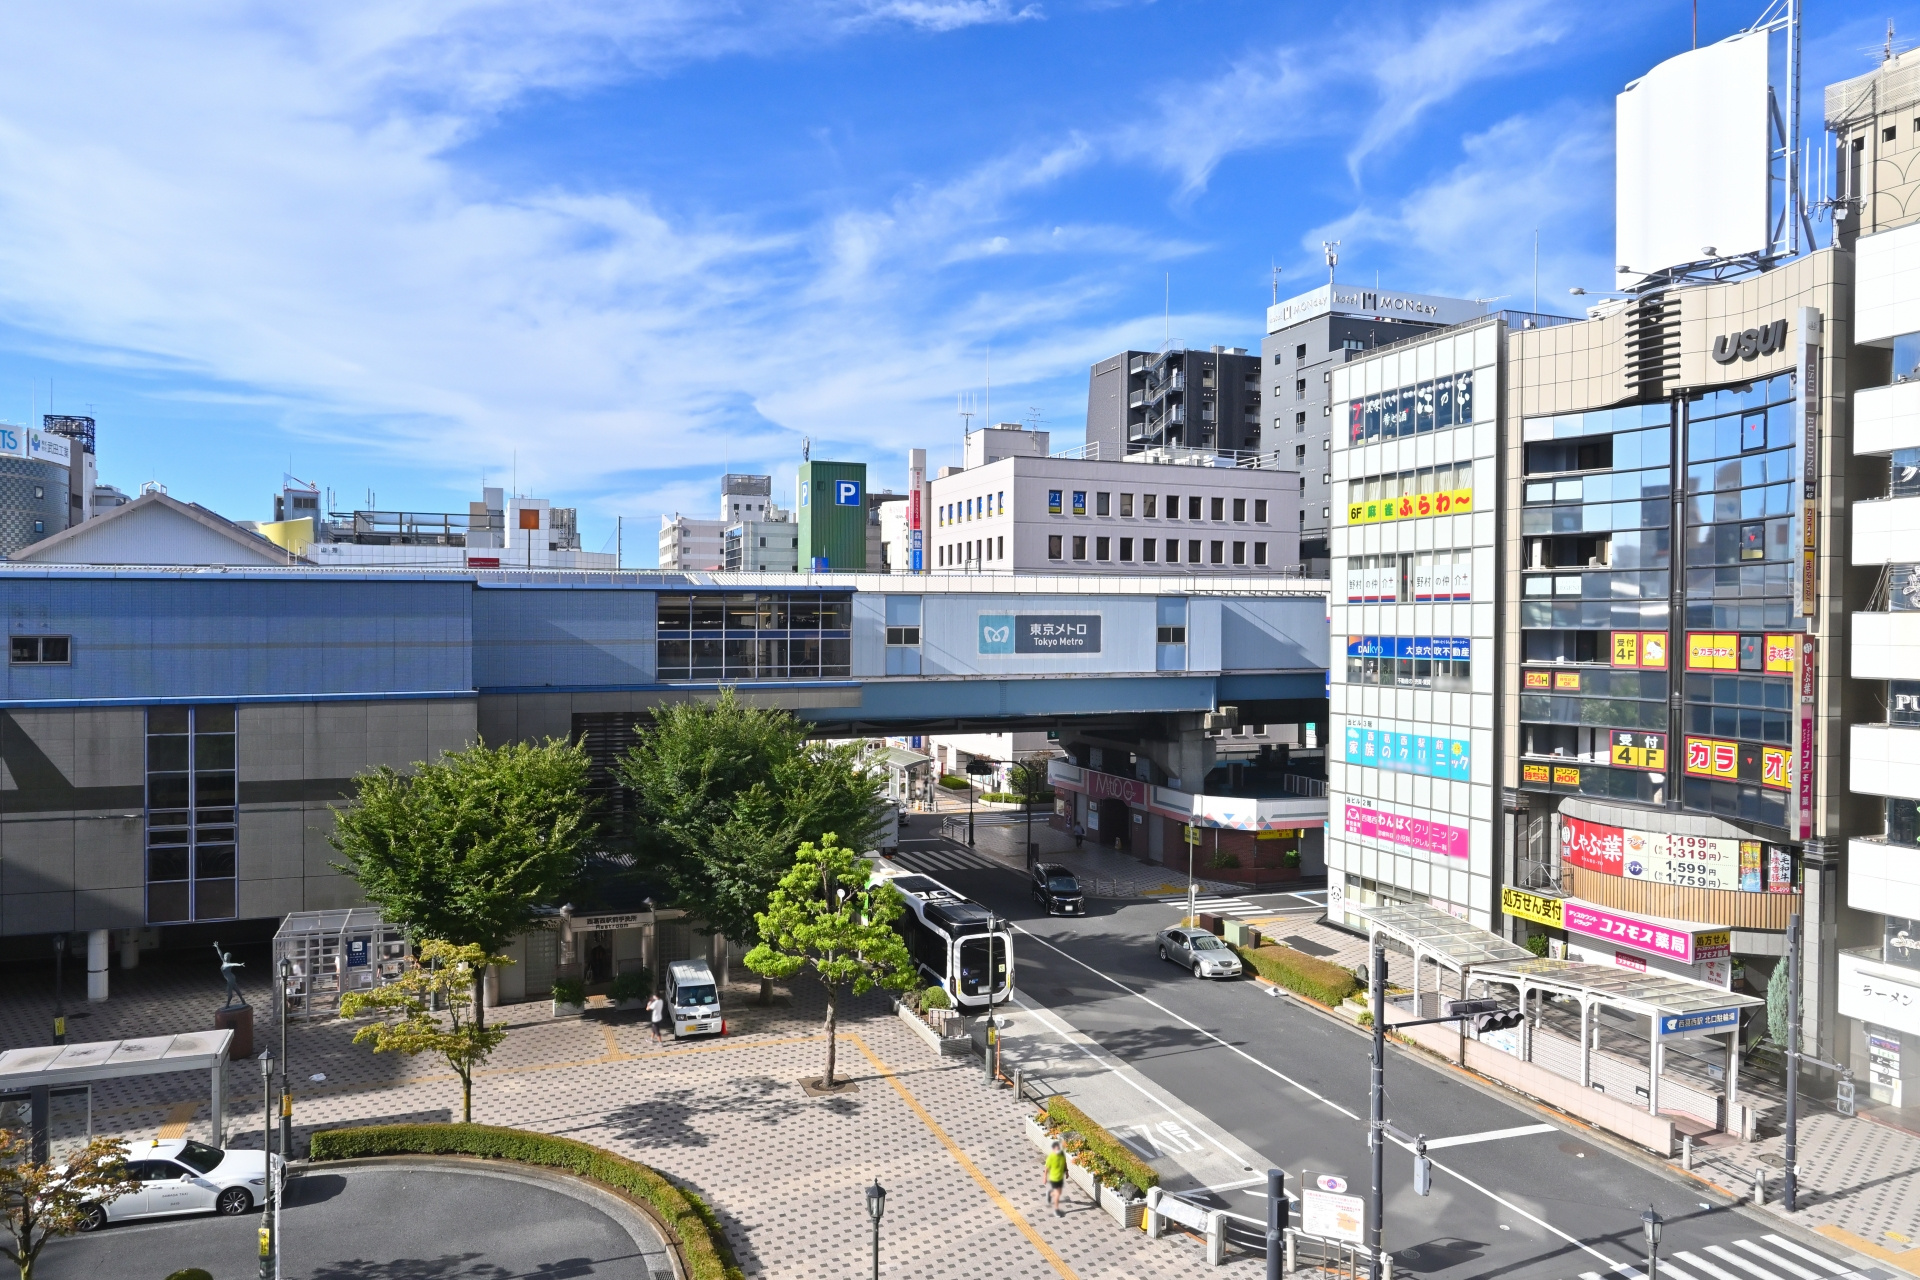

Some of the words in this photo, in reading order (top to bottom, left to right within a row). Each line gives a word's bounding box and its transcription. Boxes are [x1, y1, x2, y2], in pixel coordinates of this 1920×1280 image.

[1333, 291, 1358, 305] hotel
[1380, 296, 1438, 317] MONday
[1711, 319, 1788, 365] USUI
[1807, 364, 1815, 393] USUI
[0, 430, 18, 450] TS
[1806, 416, 1815, 476] BUILDING
[802, 484, 808, 505] P
[840, 483, 856, 504] P
[1351, 507, 1362, 520] 6F
[1029, 623, 1087, 636] 東京メトロ
[1033, 637, 1058, 647] Tokyo
[1059, 638, 1084, 646] Metro
[1405, 646, 1470, 657] 大京穴吹不動産
[1616, 638, 1635, 648] 受付
[1616, 648, 1635, 660] 4F
[1699, 647, 1728, 657] カラオケ
[1527, 673, 1548, 685] 24H
[1803, 654, 1813, 695] しゃぶ葉
[1619, 733, 1659, 749] 受付
[1349, 740, 1469, 770] 家族のクリニック
[1617, 747, 1658, 766] 4F
[1801, 749, 1810, 818] コスモス薬局
[1571, 824, 1623, 864] しゃぶ葉
[1626, 837, 1647, 847] ランチ
[1503, 889, 1562, 921] 処方せん受付
[1568, 909, 1598, 922] ディスカウント
[1599, 917, 1686, 955] コスモス薬局
[1696, 933, 1729, 947] 処方せん
[1863, 984, 1914, 1006] ラーメン
[1678, 1016, 1704, 1028] 西葛西駅
